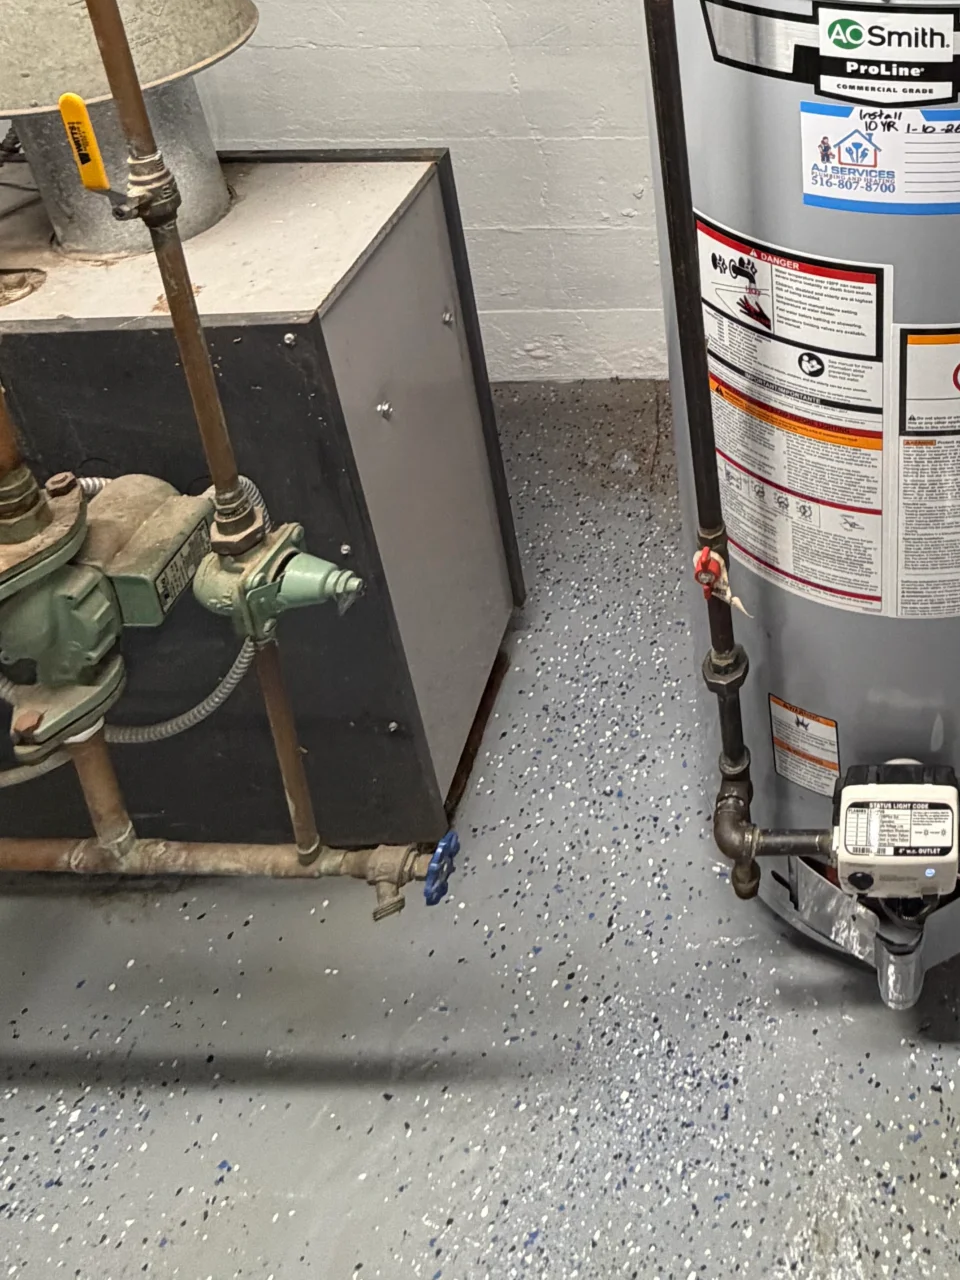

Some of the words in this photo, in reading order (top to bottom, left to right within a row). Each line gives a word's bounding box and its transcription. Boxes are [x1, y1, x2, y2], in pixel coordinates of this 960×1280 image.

[867, 25, 945, 48] Smith
[846, 61, 921, 77] ProLine
[836, 83, 898, 94] COMMERCIAL
[902, 87, 934, 95] GRADE
[859, 109, 902, 121] Install
[864, 120, 878, 132] 10
[880, 120, 899, 133] YR
[811, 171, 846, 181] PLUMBING
[831, 166, 896, 179] SERVICES
[811, 176, 896, 194] 516-807-8700
[761, 253, 800, 270] DANGER
